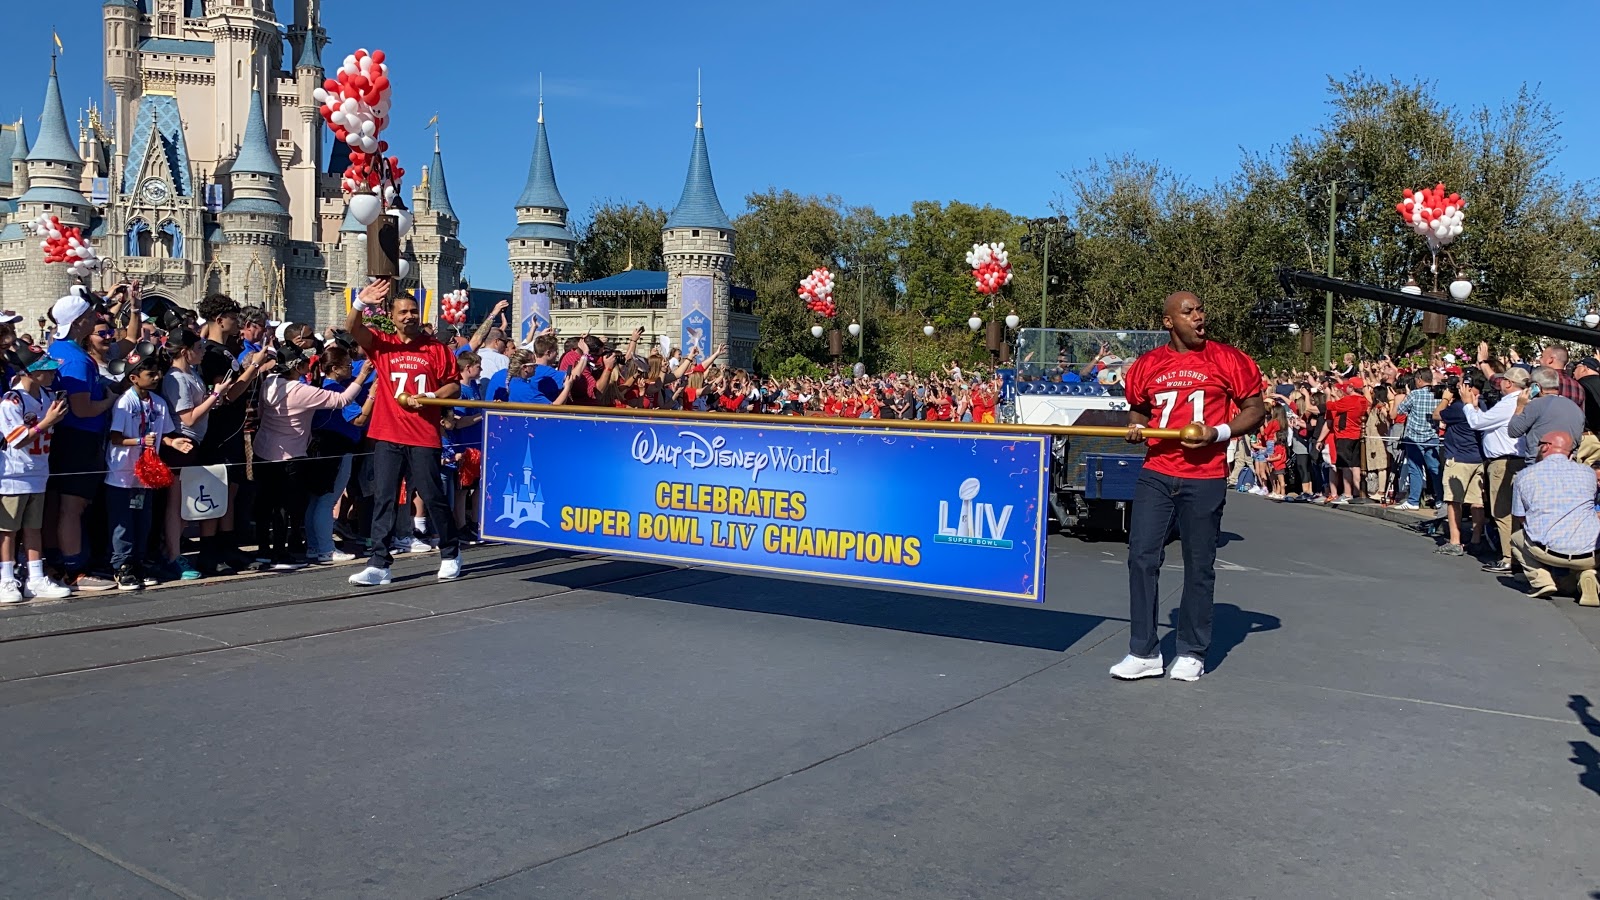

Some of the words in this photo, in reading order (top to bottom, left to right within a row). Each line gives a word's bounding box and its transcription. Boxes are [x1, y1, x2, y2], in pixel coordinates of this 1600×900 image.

[391, 356, 405, 364] WALT
[406, 356, 429, 366] DISNEY
[391, 372, 427, 399] 71
[1155, 371, 1177, 384] WALT
[1179, 370, 1208, 383] DISNEY
[1154, 390, 1205, 429] 71
[655, 480, 807, 520] CELEBRATES
[559, 504, 632, 538] SUPER
[637, 511, 704, 546] BOWL
[711, 520, 758, 551] LIV
[762, 524, 922, 568] CHAMPIONS
[947, 536, 973, 544] SUPER
[976, 538, 998, 547] BOWL
